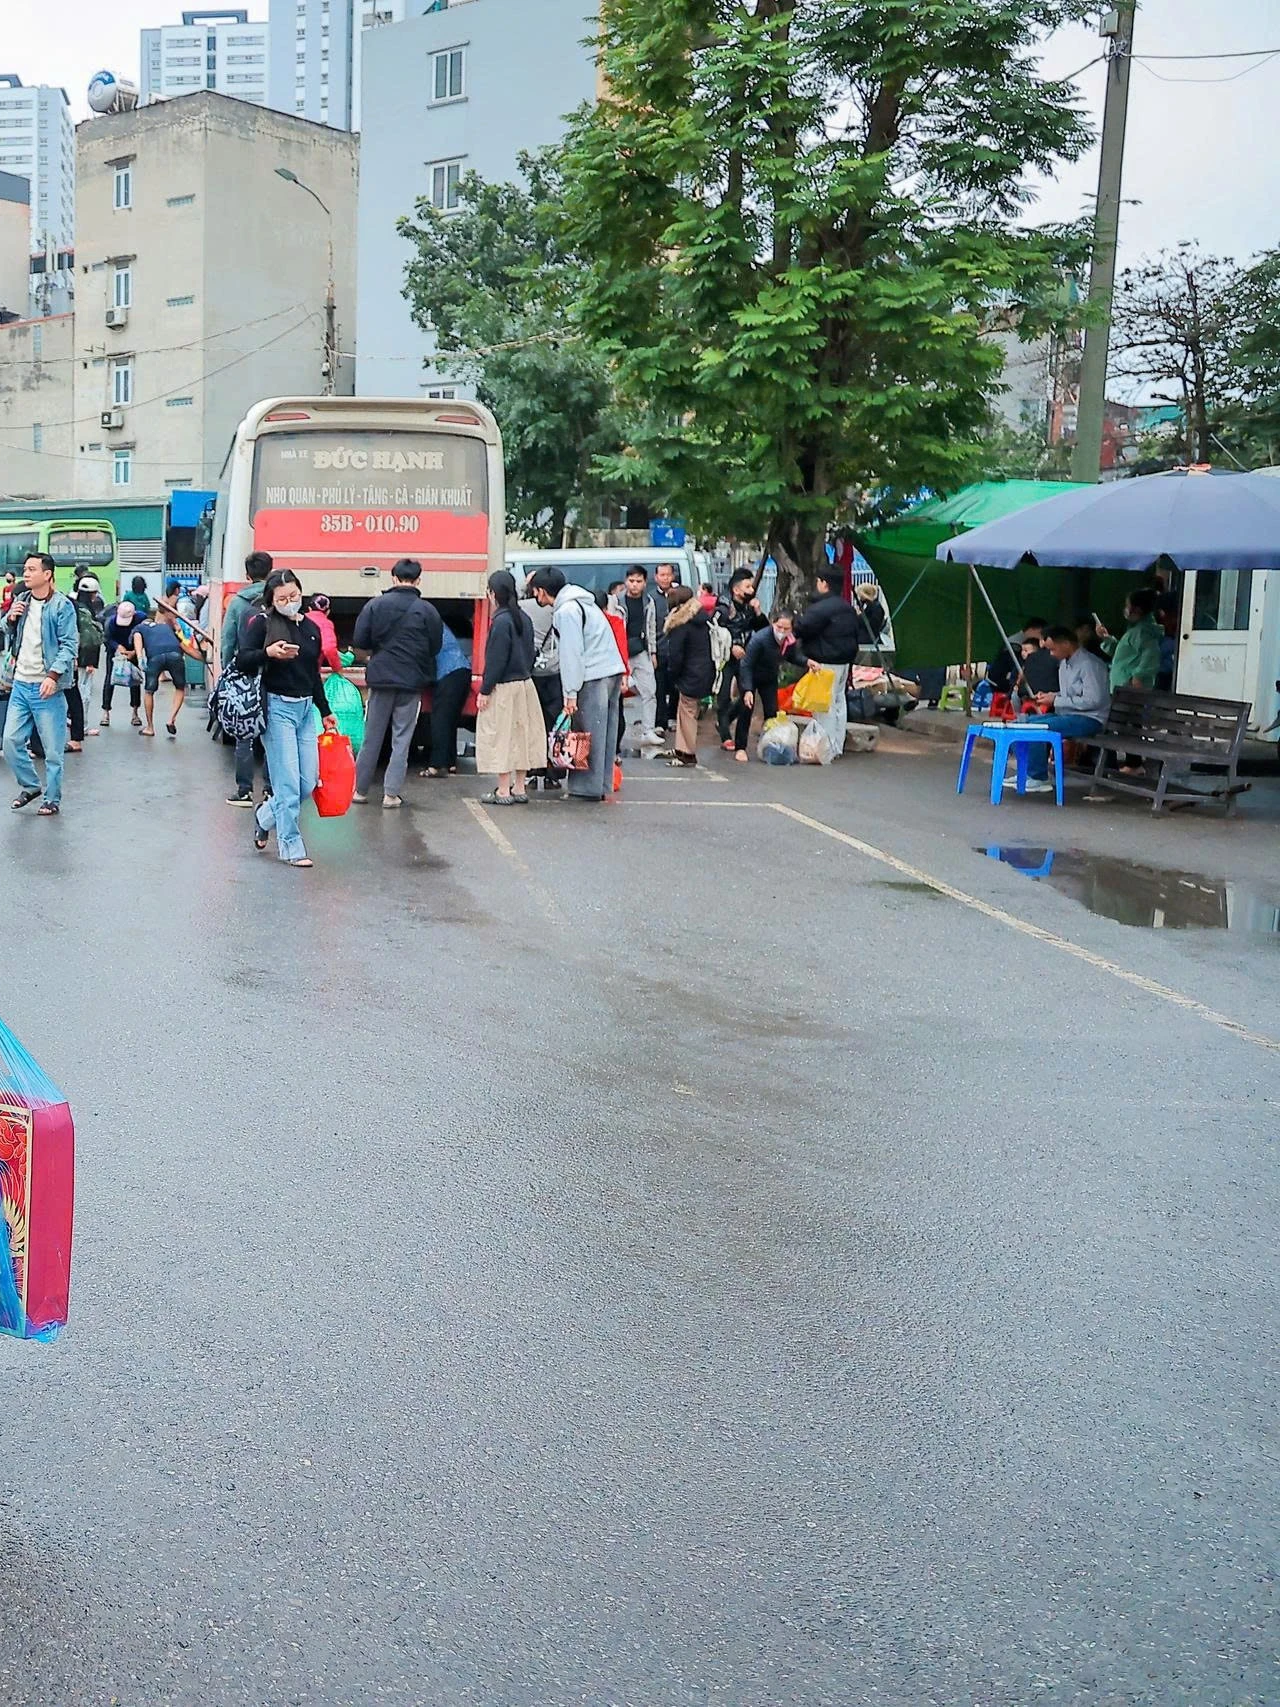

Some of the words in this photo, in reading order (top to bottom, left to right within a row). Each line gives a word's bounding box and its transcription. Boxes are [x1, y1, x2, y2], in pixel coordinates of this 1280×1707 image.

[313, 446, 369, 470] ĐỨC
[372, 450, 444, 473] HẠNH
[266, 487, 287, 504] NHO
[288, 487, 316, 506] QUAN
[321, 515, 353, 532] 35B
